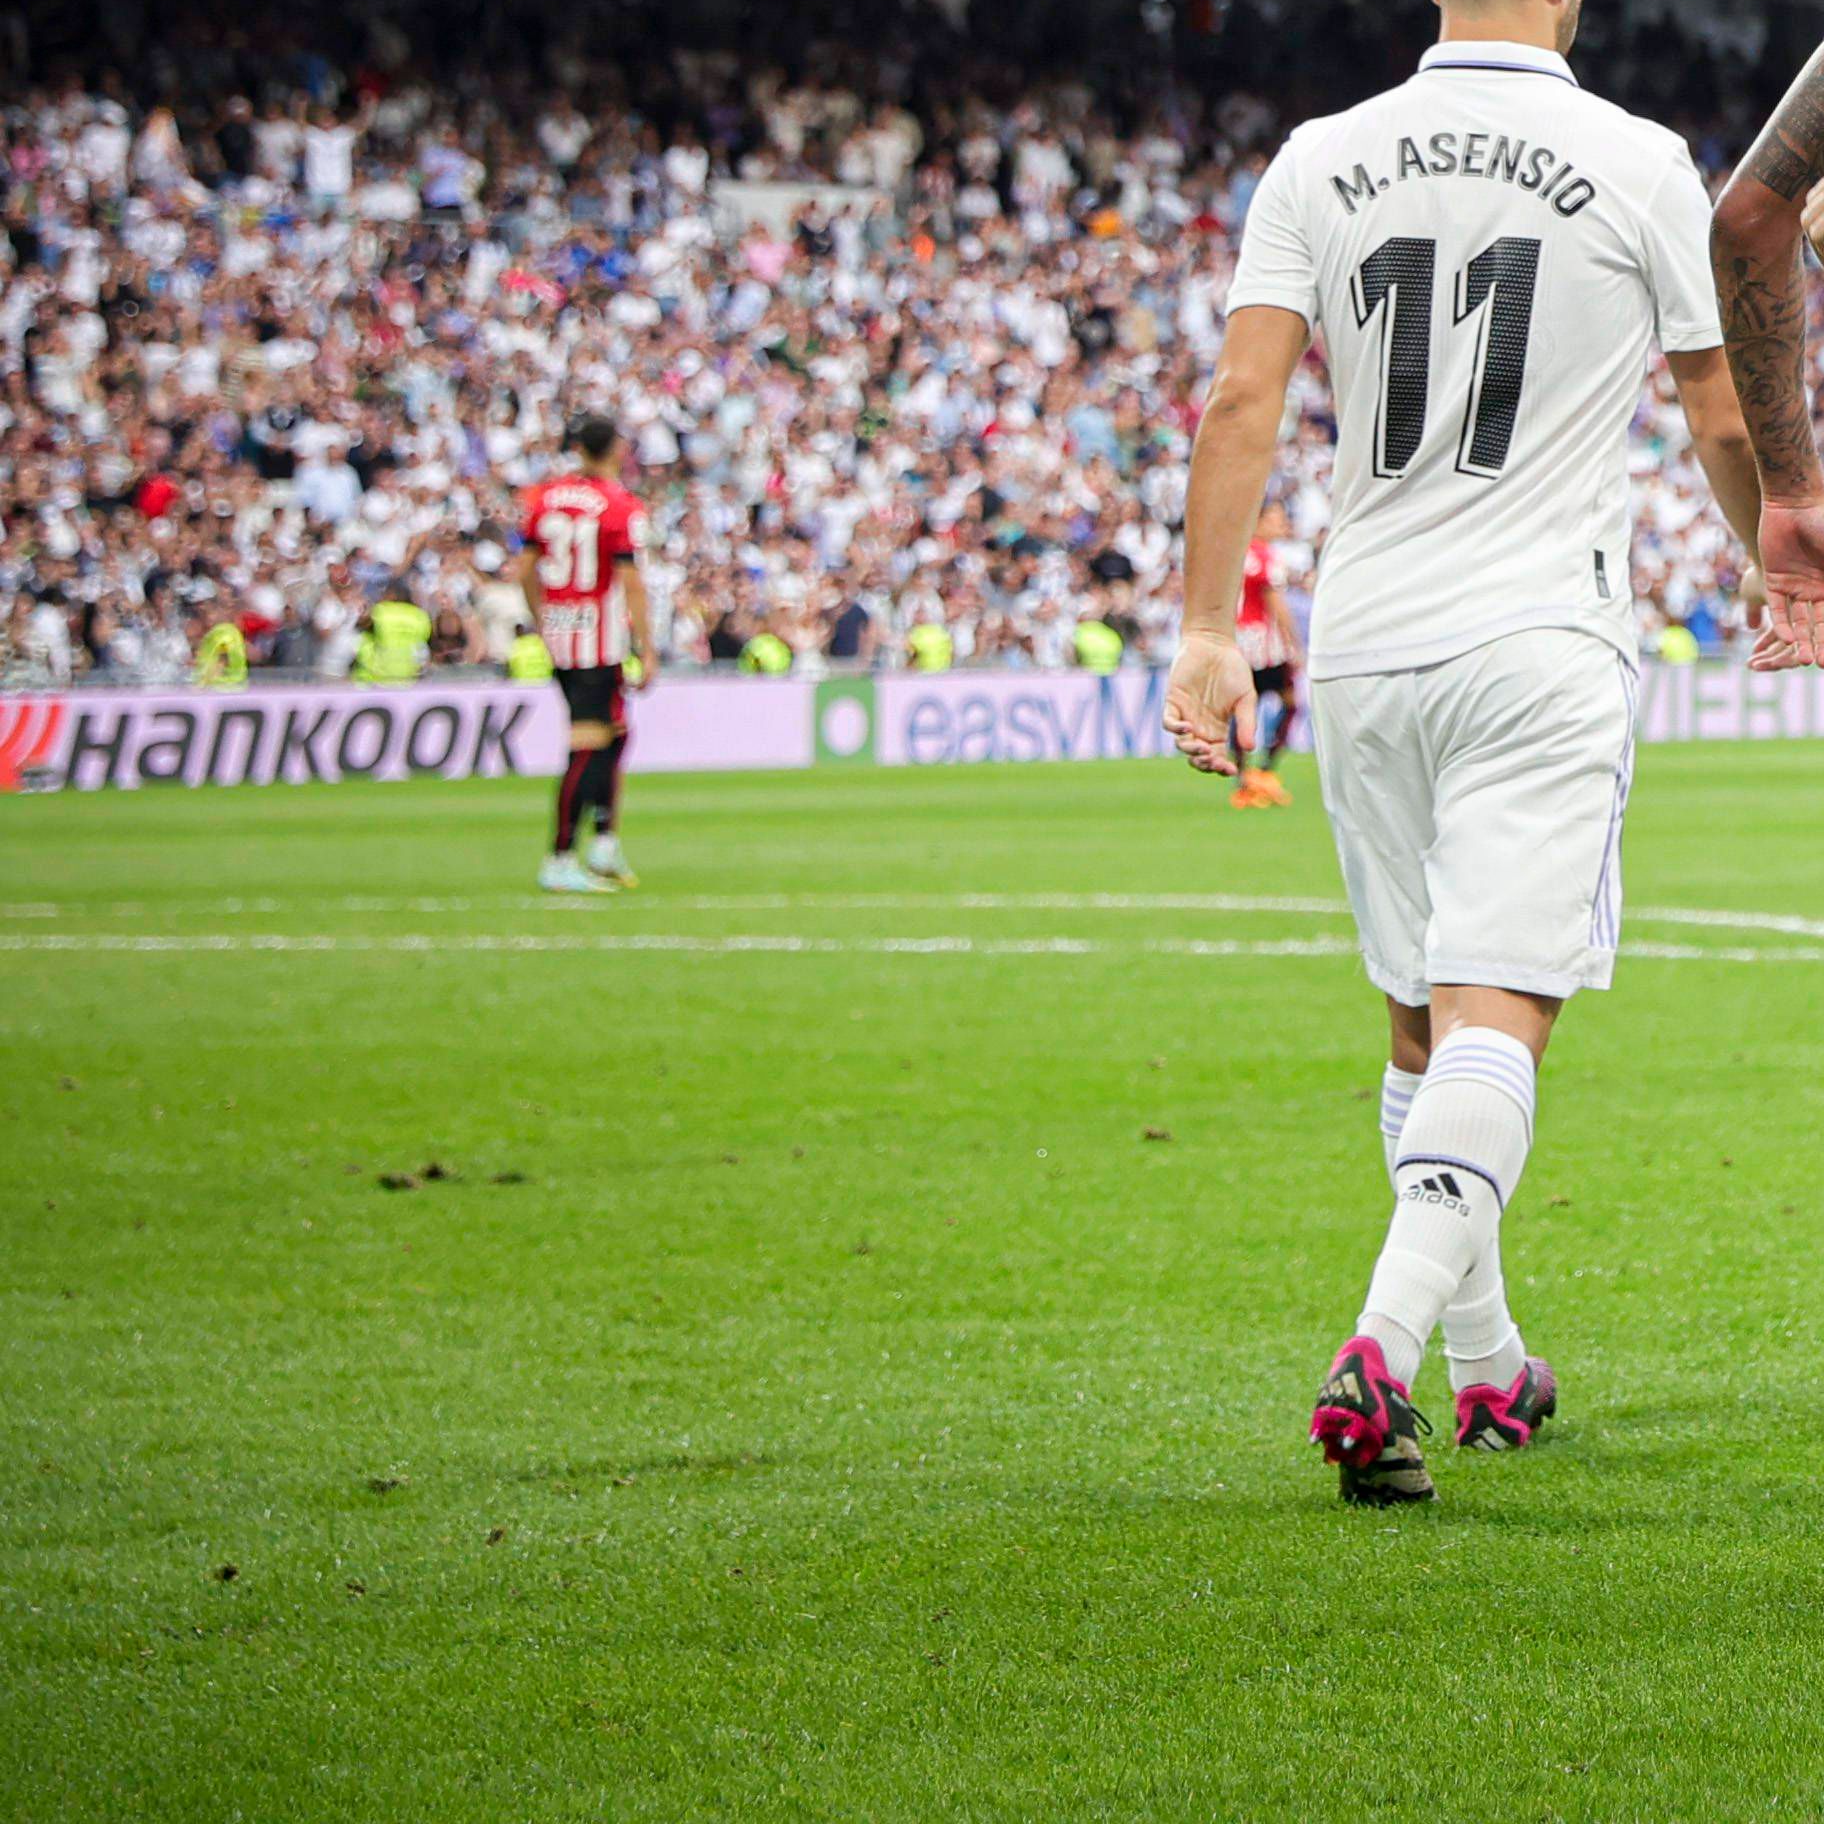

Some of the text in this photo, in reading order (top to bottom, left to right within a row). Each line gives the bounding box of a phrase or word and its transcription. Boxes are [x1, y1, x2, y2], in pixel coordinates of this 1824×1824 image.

[1330, 132, 1597, 218] M. ASENSIO
[1350, 237, 1542, 480] 11
[537, 510, 600, 592] 31
